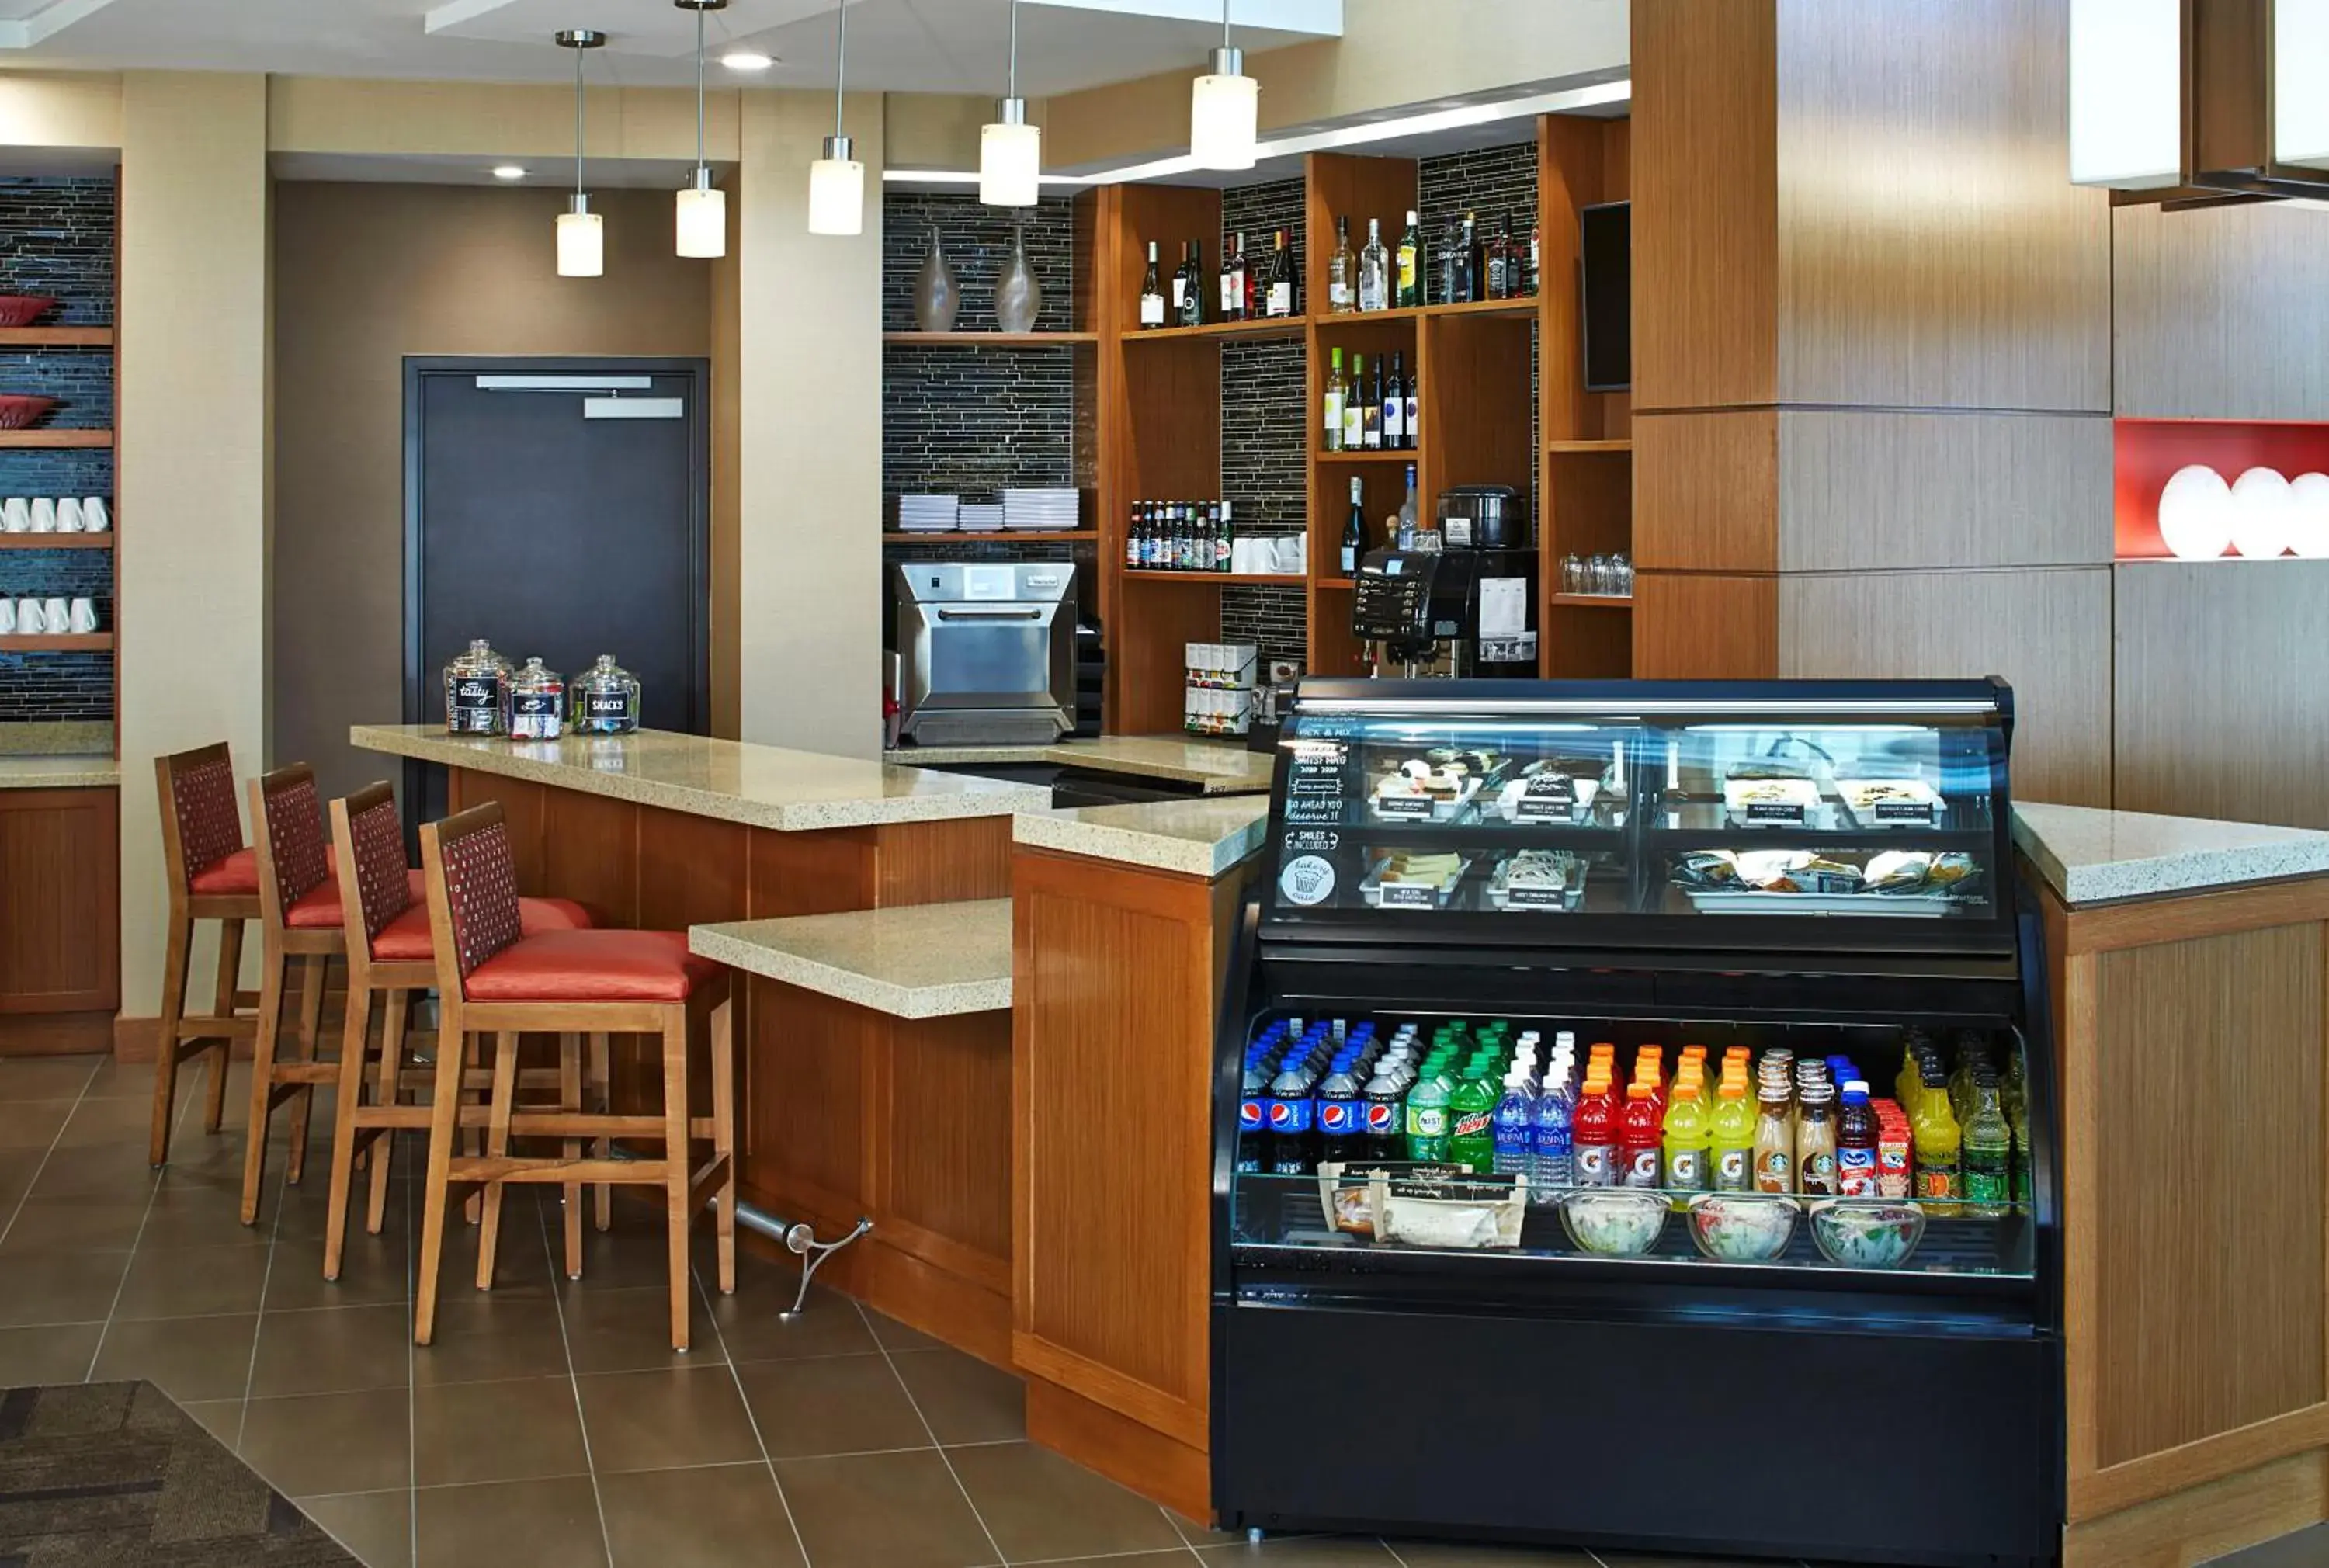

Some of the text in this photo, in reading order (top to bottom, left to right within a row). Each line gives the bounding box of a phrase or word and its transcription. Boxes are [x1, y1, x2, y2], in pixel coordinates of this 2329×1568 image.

[460, 685, 495, 706] tasty
[592, 700, 623, 710] SNACKS
[1299, 831, 1325, 840] SMILES
